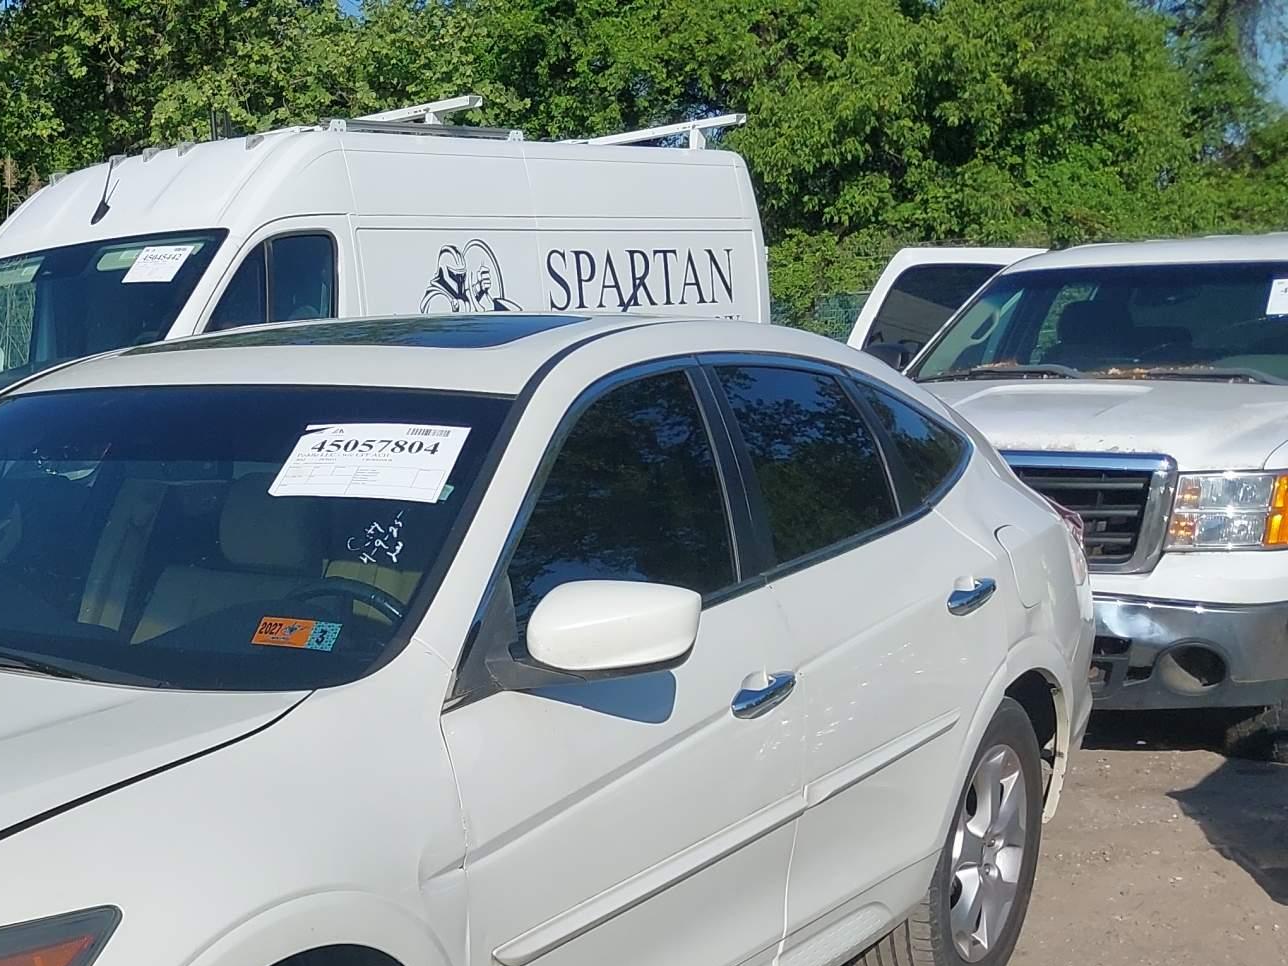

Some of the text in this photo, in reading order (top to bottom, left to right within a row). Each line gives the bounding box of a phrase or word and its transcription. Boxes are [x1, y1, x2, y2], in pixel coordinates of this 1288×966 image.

[546, 248, 734, 311] SPARTAN
[311, 438, 441, 455] 45057804
[259, 622, 283, 636] 2027
[315, 629, 328, 646] 3
